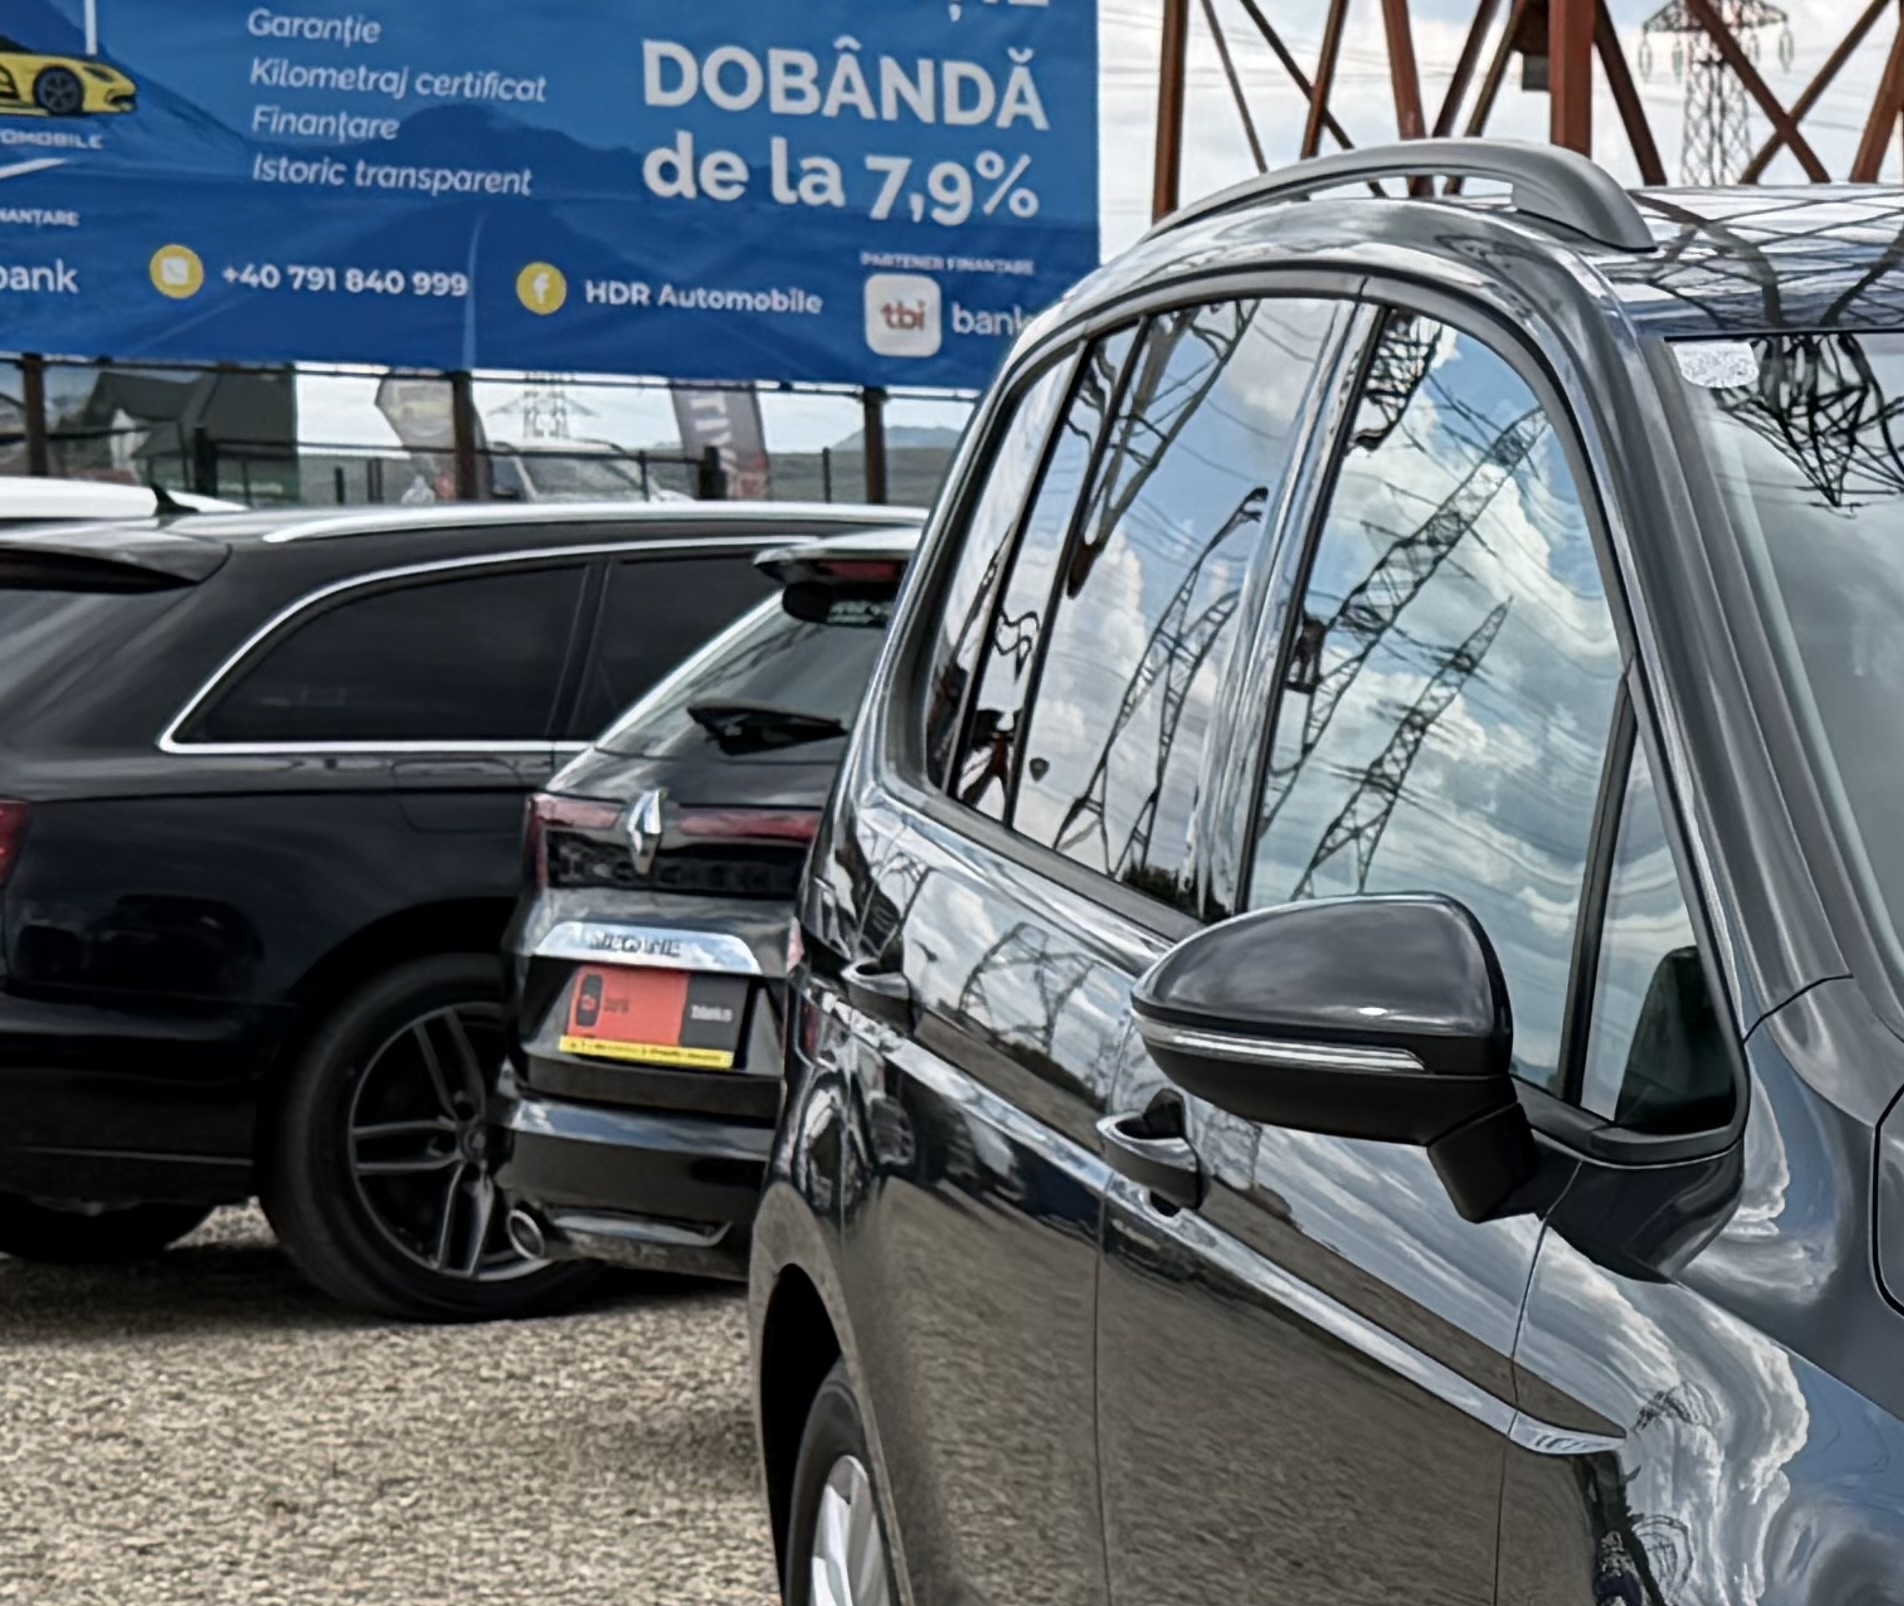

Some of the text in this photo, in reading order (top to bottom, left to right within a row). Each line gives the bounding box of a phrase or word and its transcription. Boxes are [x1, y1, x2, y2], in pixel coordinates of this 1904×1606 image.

[250, 57, 547, 103] Kilometraj certificat
[642, 35, 1050, 131] DOBÂNDĂ
[253, 153, 532, 197] Istoric transparent
[642, 129, 1039, 226] de la 7,9%
[223, 263, 469, 297] +40 791 840 999
[585, 279, 823, 315] HDR Automobile
[881, 300, 926, 331] tbi
